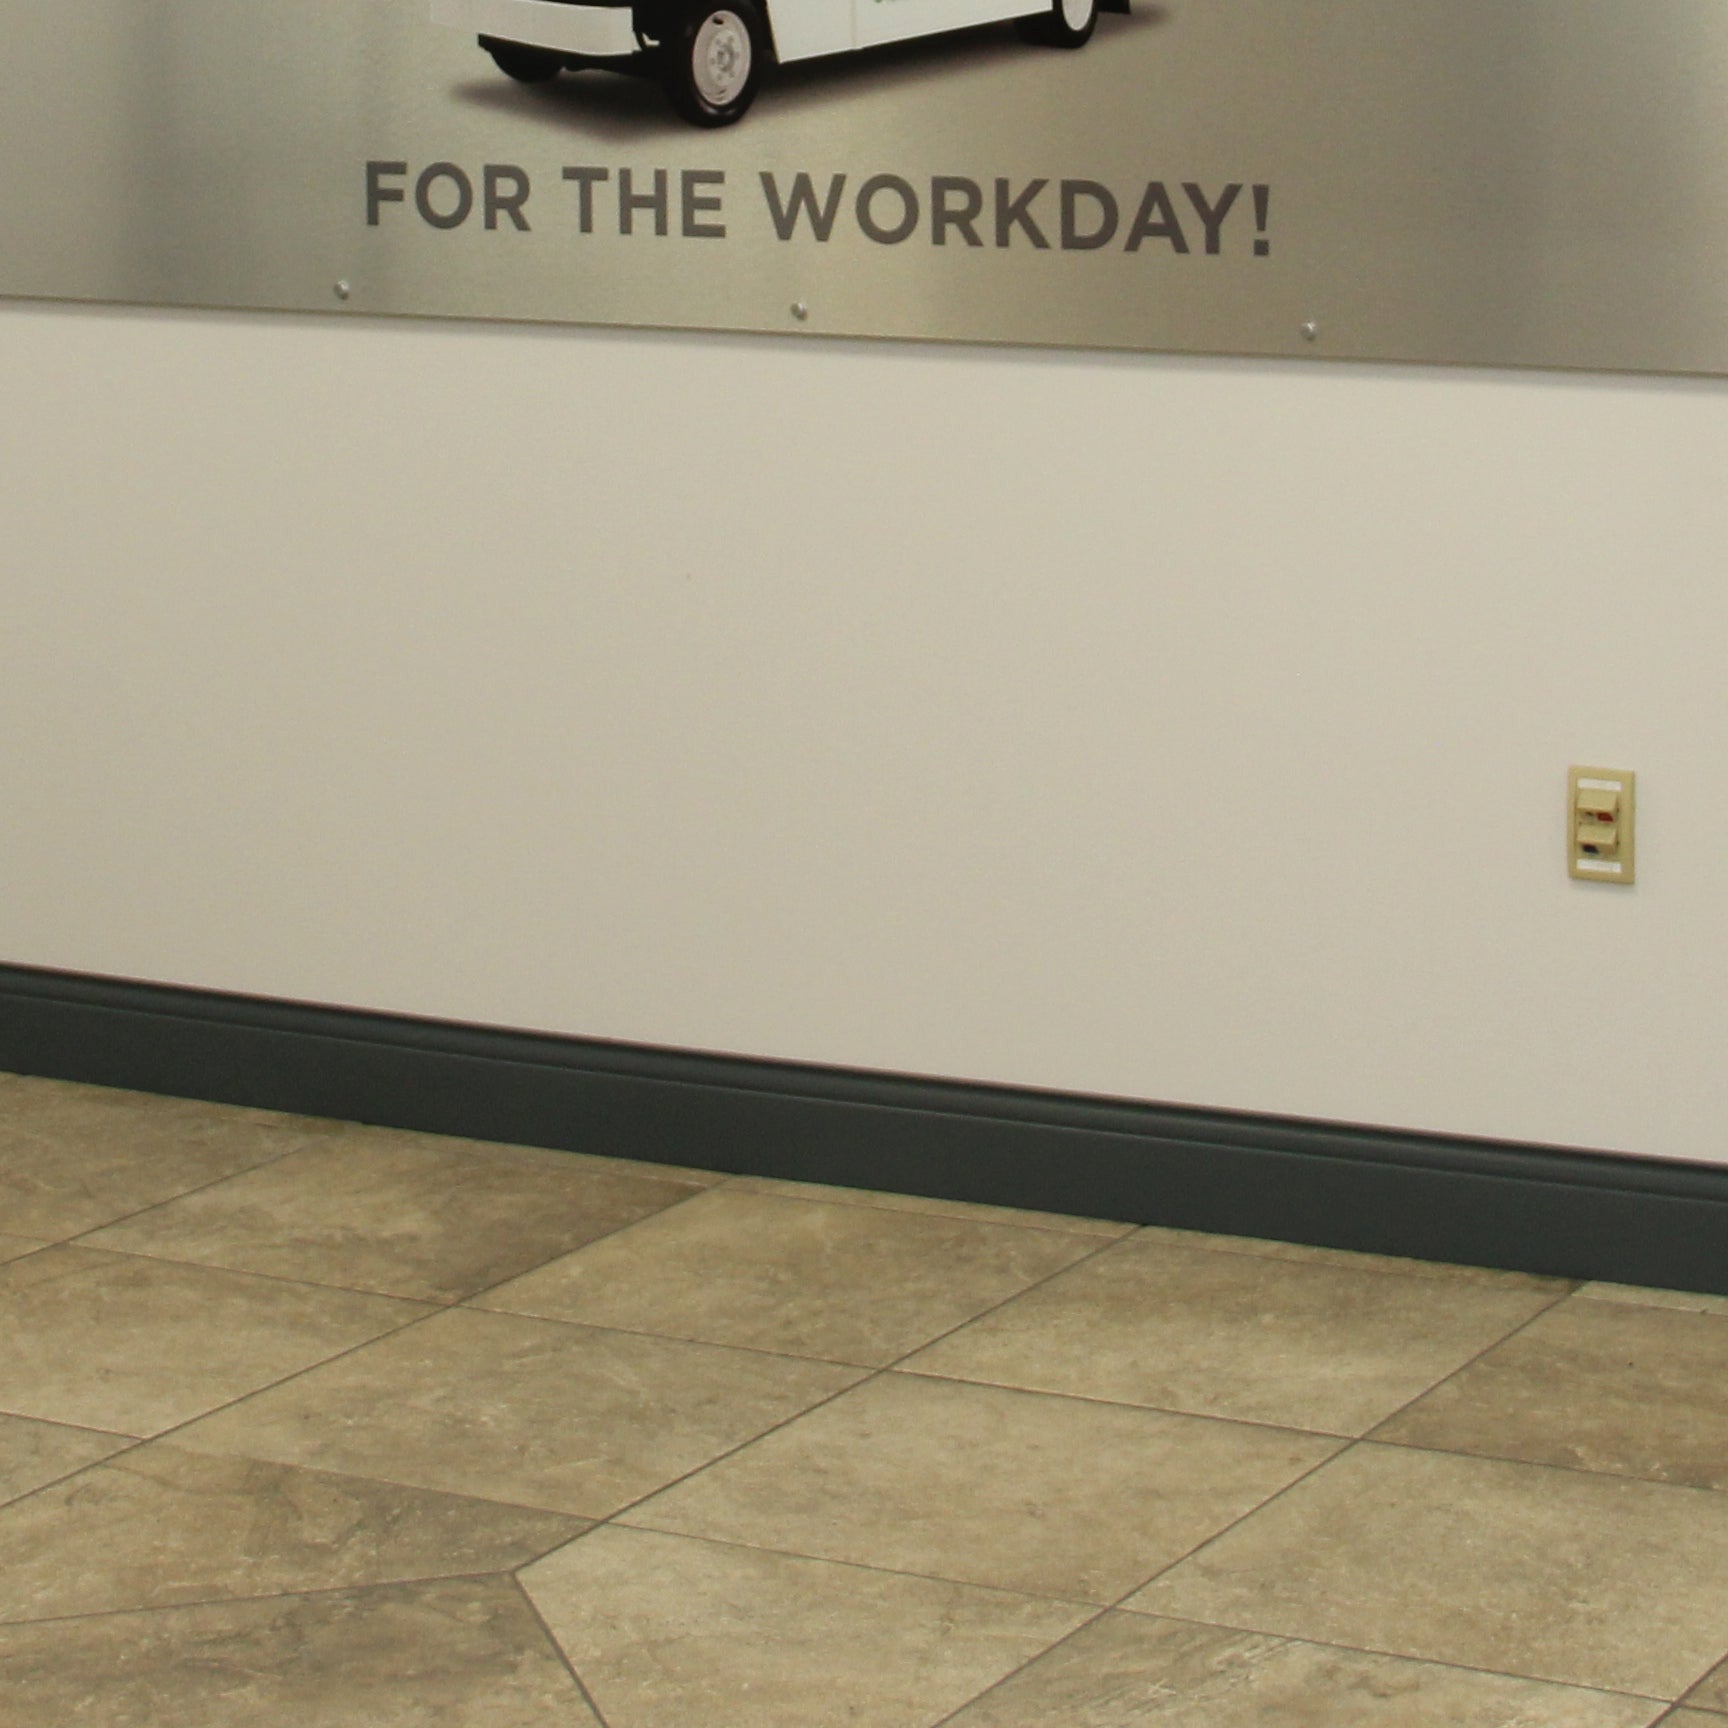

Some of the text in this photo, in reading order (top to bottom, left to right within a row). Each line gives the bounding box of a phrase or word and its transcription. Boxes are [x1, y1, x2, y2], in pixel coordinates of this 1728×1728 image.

[366, 160, 1271, 257] FOR THE WORKDAY!
